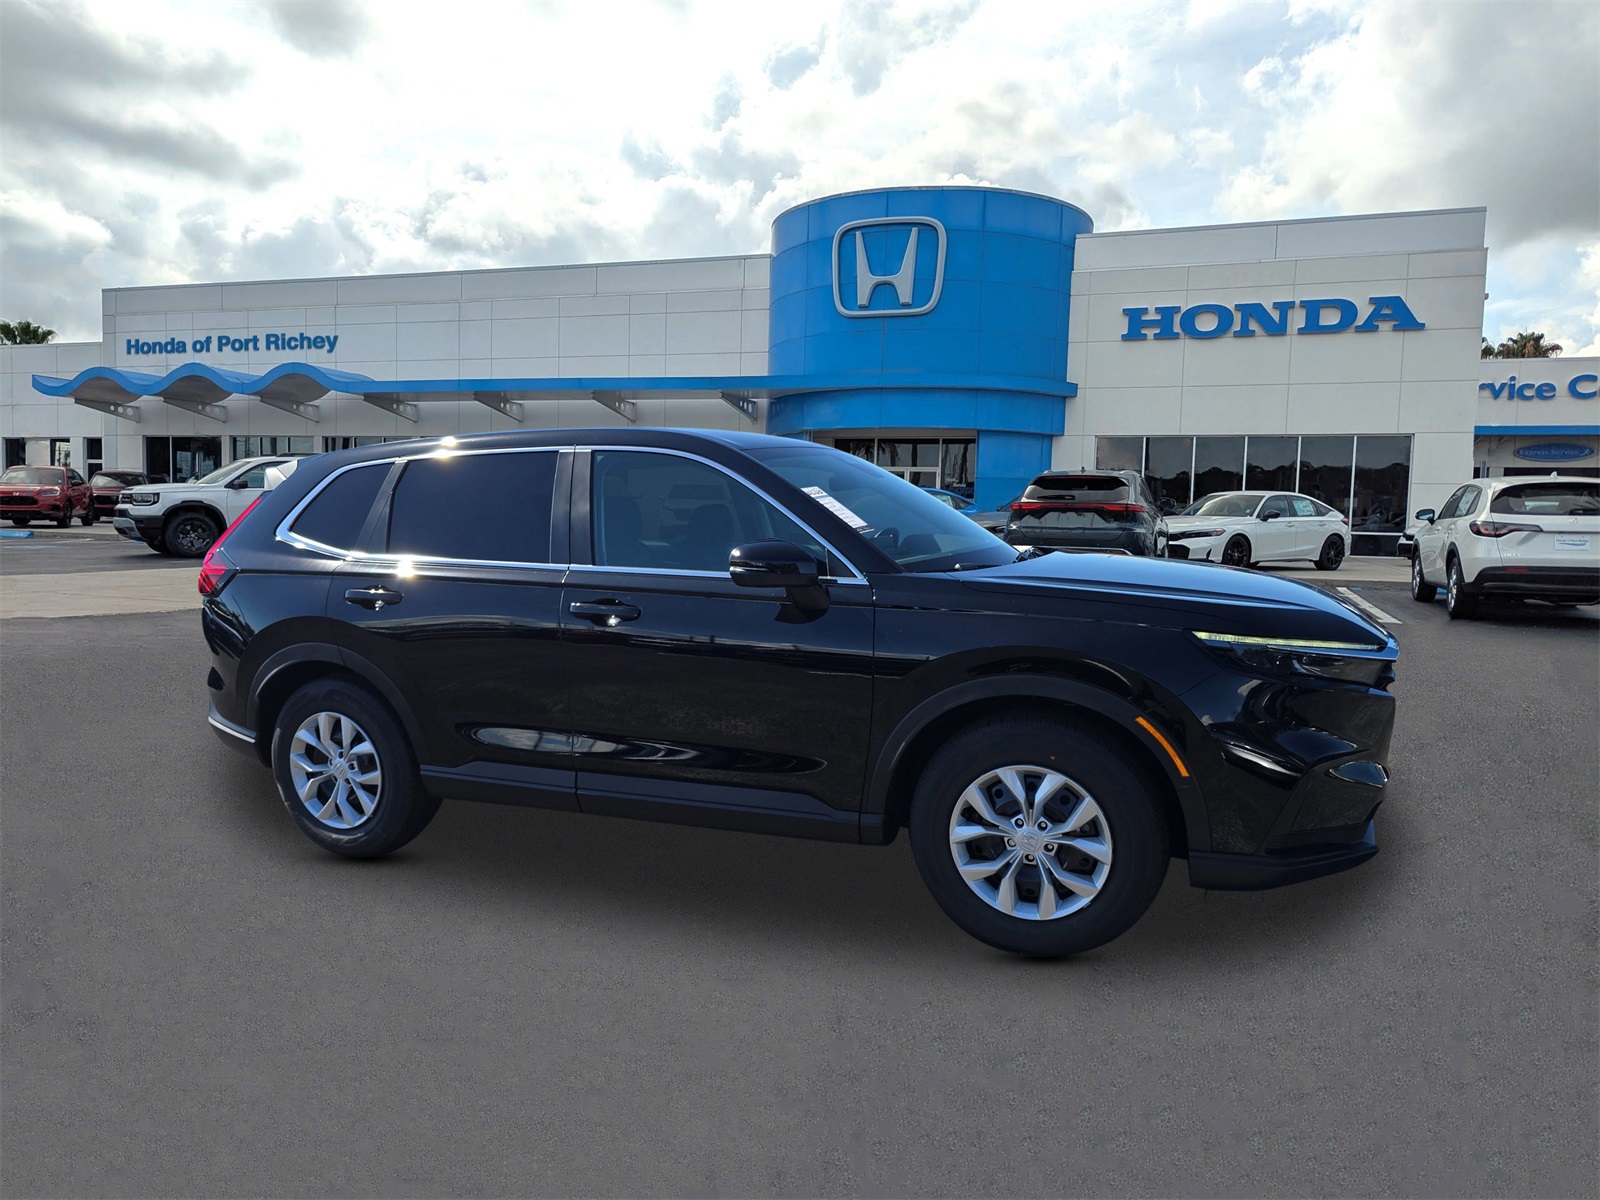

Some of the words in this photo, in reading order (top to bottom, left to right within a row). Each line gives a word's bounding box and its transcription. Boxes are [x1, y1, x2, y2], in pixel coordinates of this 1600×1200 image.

[1121, 295, 1426, 341] HONDA
[126, 337, 187, 355] Honda
[192, 336, 212, 353] of
[217, 335, 259, 352] Port
[265, 332, 339, 354] Richey
[1567, 373, 1600, 400] C
